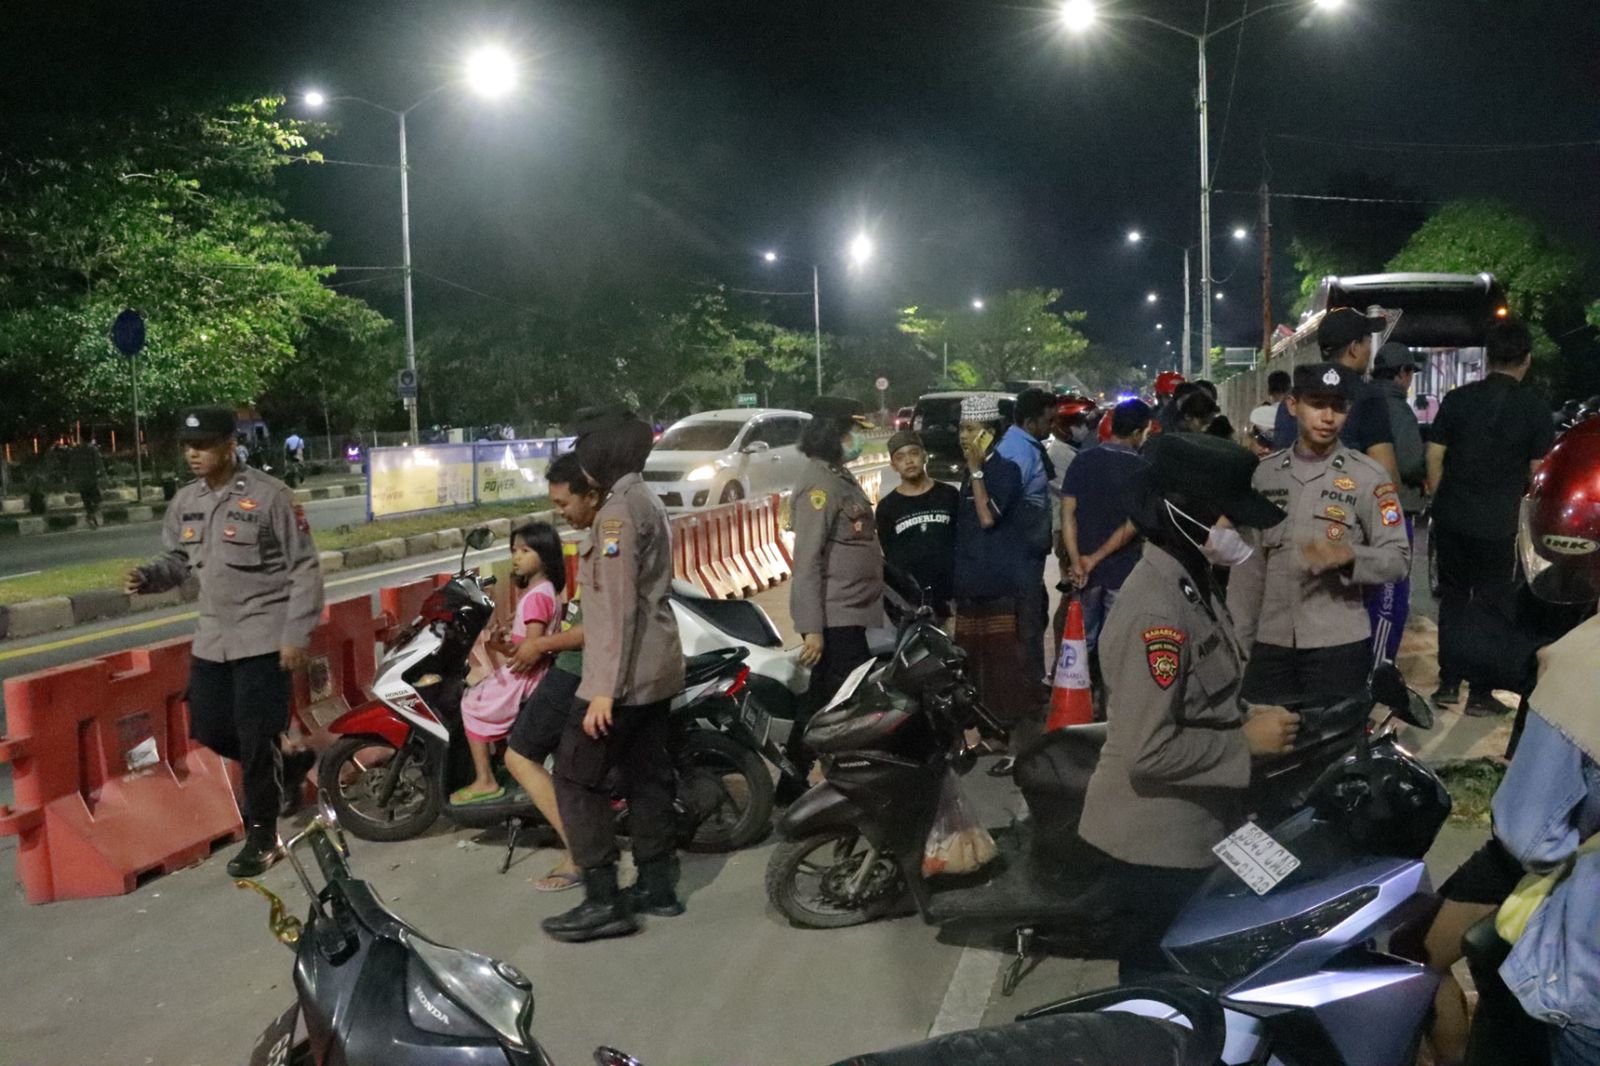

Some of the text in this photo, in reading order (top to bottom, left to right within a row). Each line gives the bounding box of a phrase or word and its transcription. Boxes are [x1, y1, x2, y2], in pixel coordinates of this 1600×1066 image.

[1320, 490, 1357, 506] POLRI
[226, 511, 258, 523] POLRI
[384, 689, 409, 698] HONDA
[414, 985, 450, 1025] HONDA
